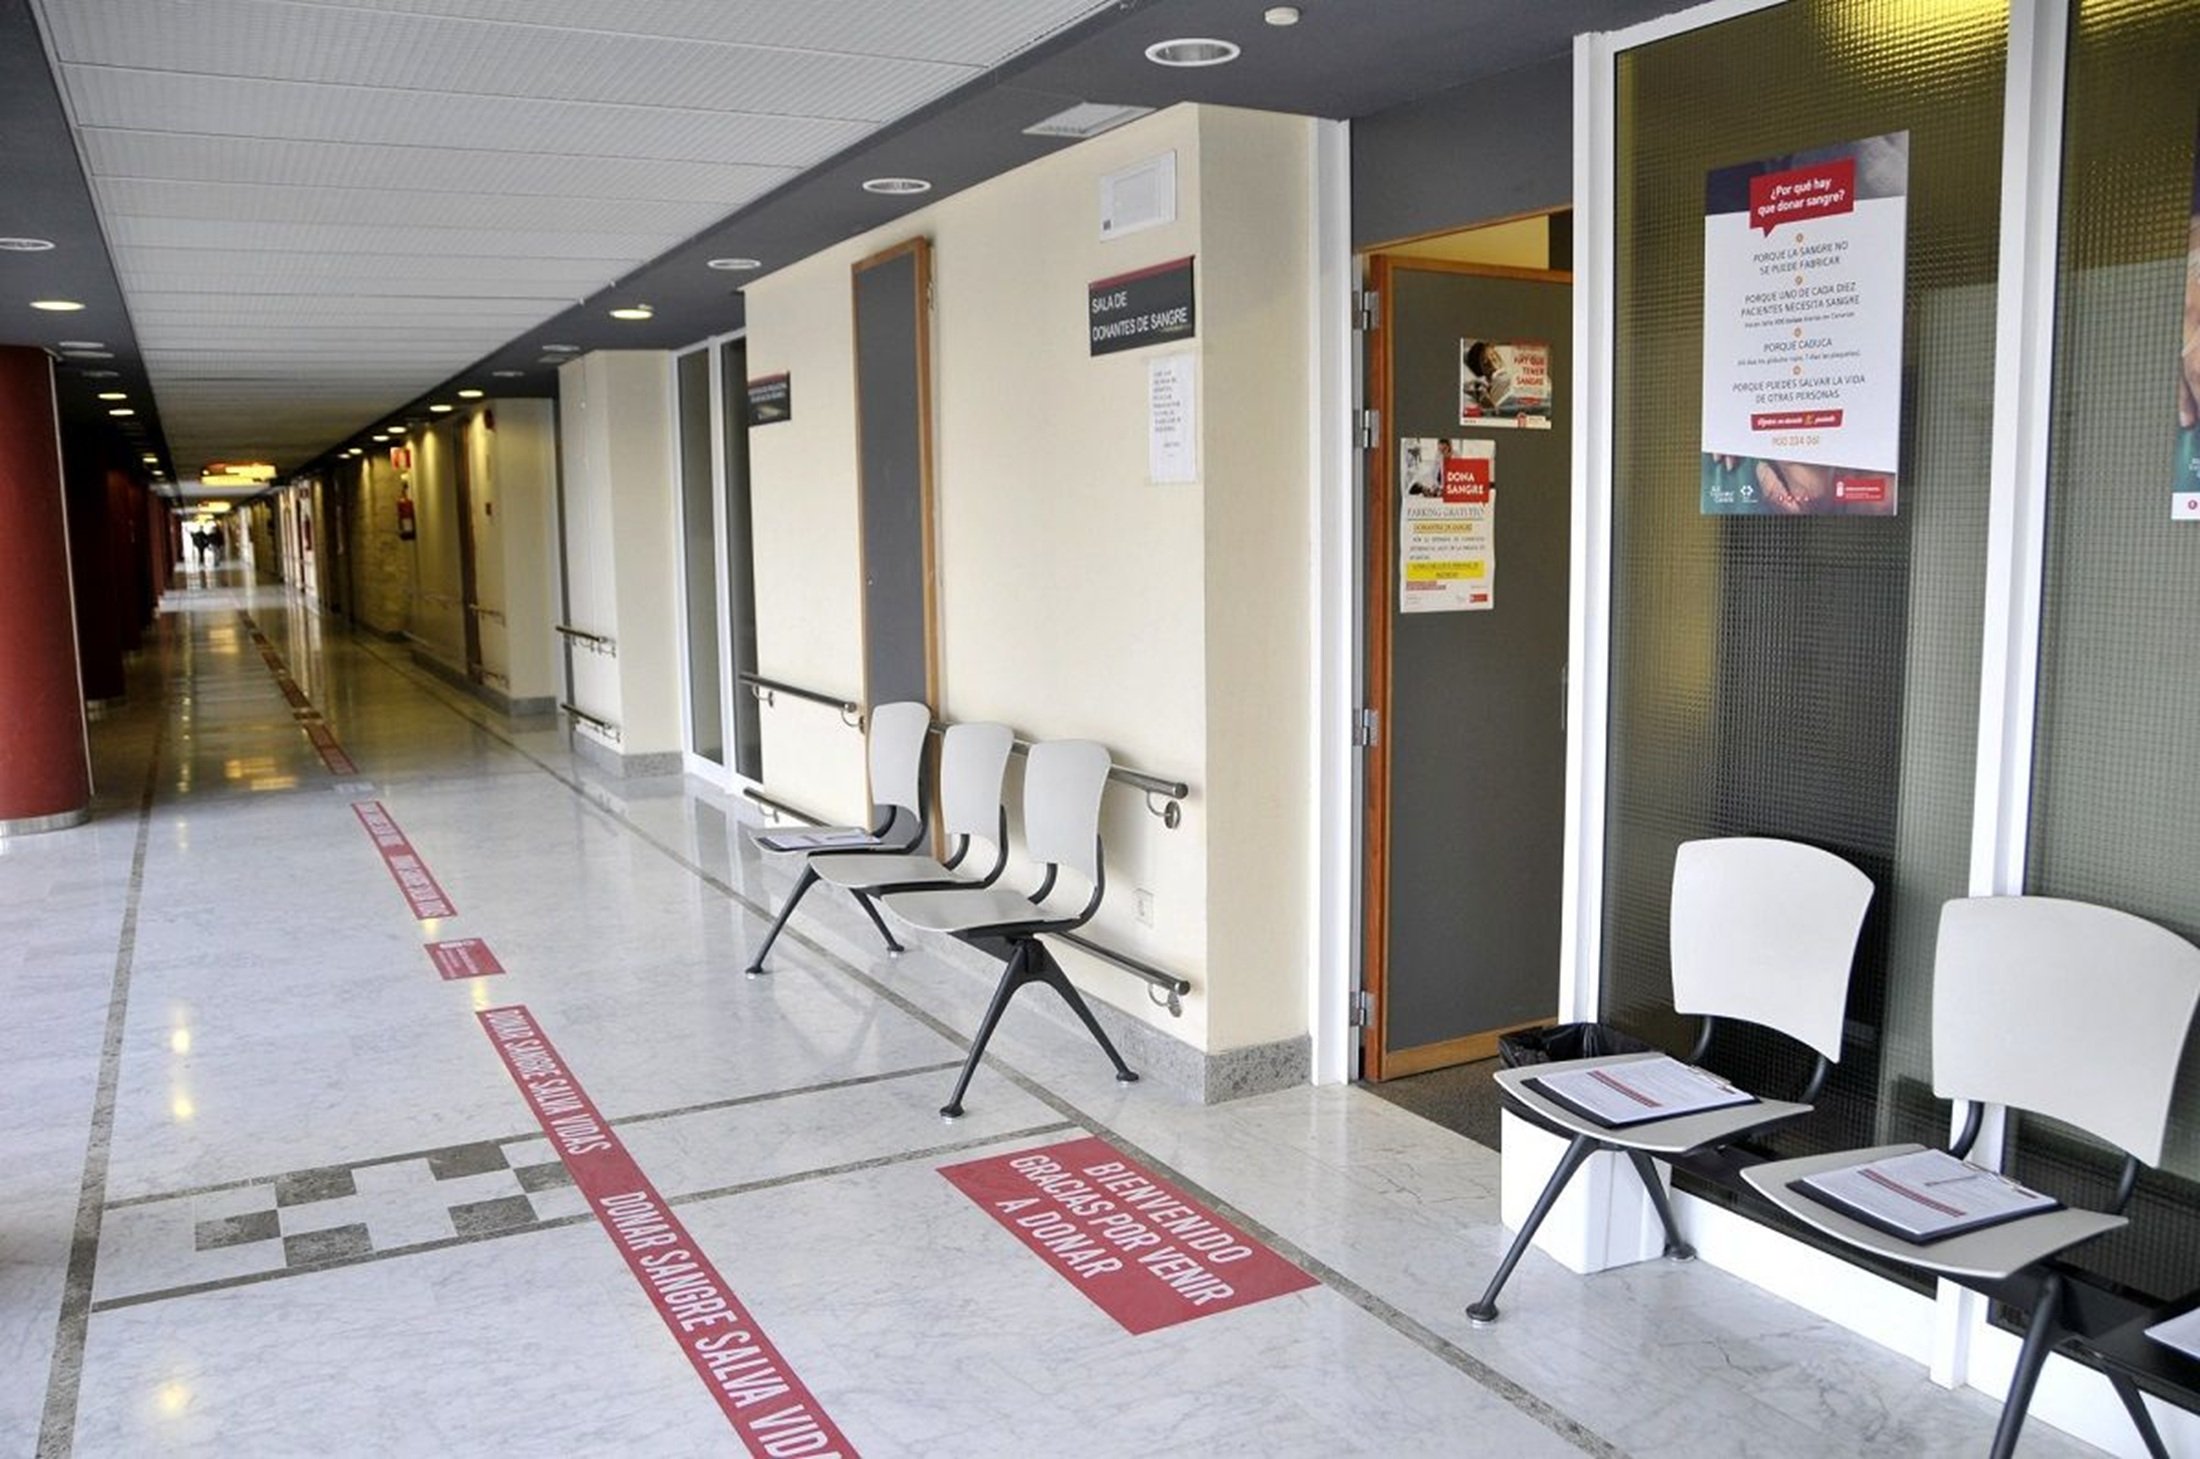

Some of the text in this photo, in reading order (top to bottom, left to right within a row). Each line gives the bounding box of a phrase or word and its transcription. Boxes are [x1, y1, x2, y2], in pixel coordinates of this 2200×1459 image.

[1770, 177, 1832, 200] ¿Por qué hay
[1758, 189, 1845, 218] que donar sangre?
[1753, 241, 1849, 263] PORQUE LA SANGRE NO
[1760, 257, 1840, 276] SE PUEDE FABRICAR
[1092, 291, 1127, 314] SALA DE
[1745, 282, 1856, 304] PORQUE UNO DE CADA DIEZ
[1741, 296, 1860, 318] PACIENTES NECESITA SANGRE
[1092, 316, 1136, 342] DONANTES
[1137, 314, 1149, 332] DE
[1150, 307, 1188, 330] SANGRE
[1764, 338, 1833, 353] PORQUE CADUCA
[1732, 374, 1865, 393] PORQUE PUEDES SALVAR LA VIDA
[1756, 389, 1840, 404] DE OTRAS PERSONAS
[1447, 472, 1475, 482] DONA
[1446, 484, 1484, 495] SANGRE
[504, 1038, 562, 1081] SANGRE
[528, 1078, 584, 1116] SALVA
[550, 1113, 612, 1155] VIDAS
[1083, 1160, 1252, 1264] BIENVENIDO
[995, 1198, 1123, 1280] A DONAR
[1009, 1154, 1235, 1306] GRACIAS POR VENIR
[600, 1190, 678, 1252] DONAR
[639, 1249, 738, 1333] SANGRE
[694, 1330, 790, 1409] SALVA
